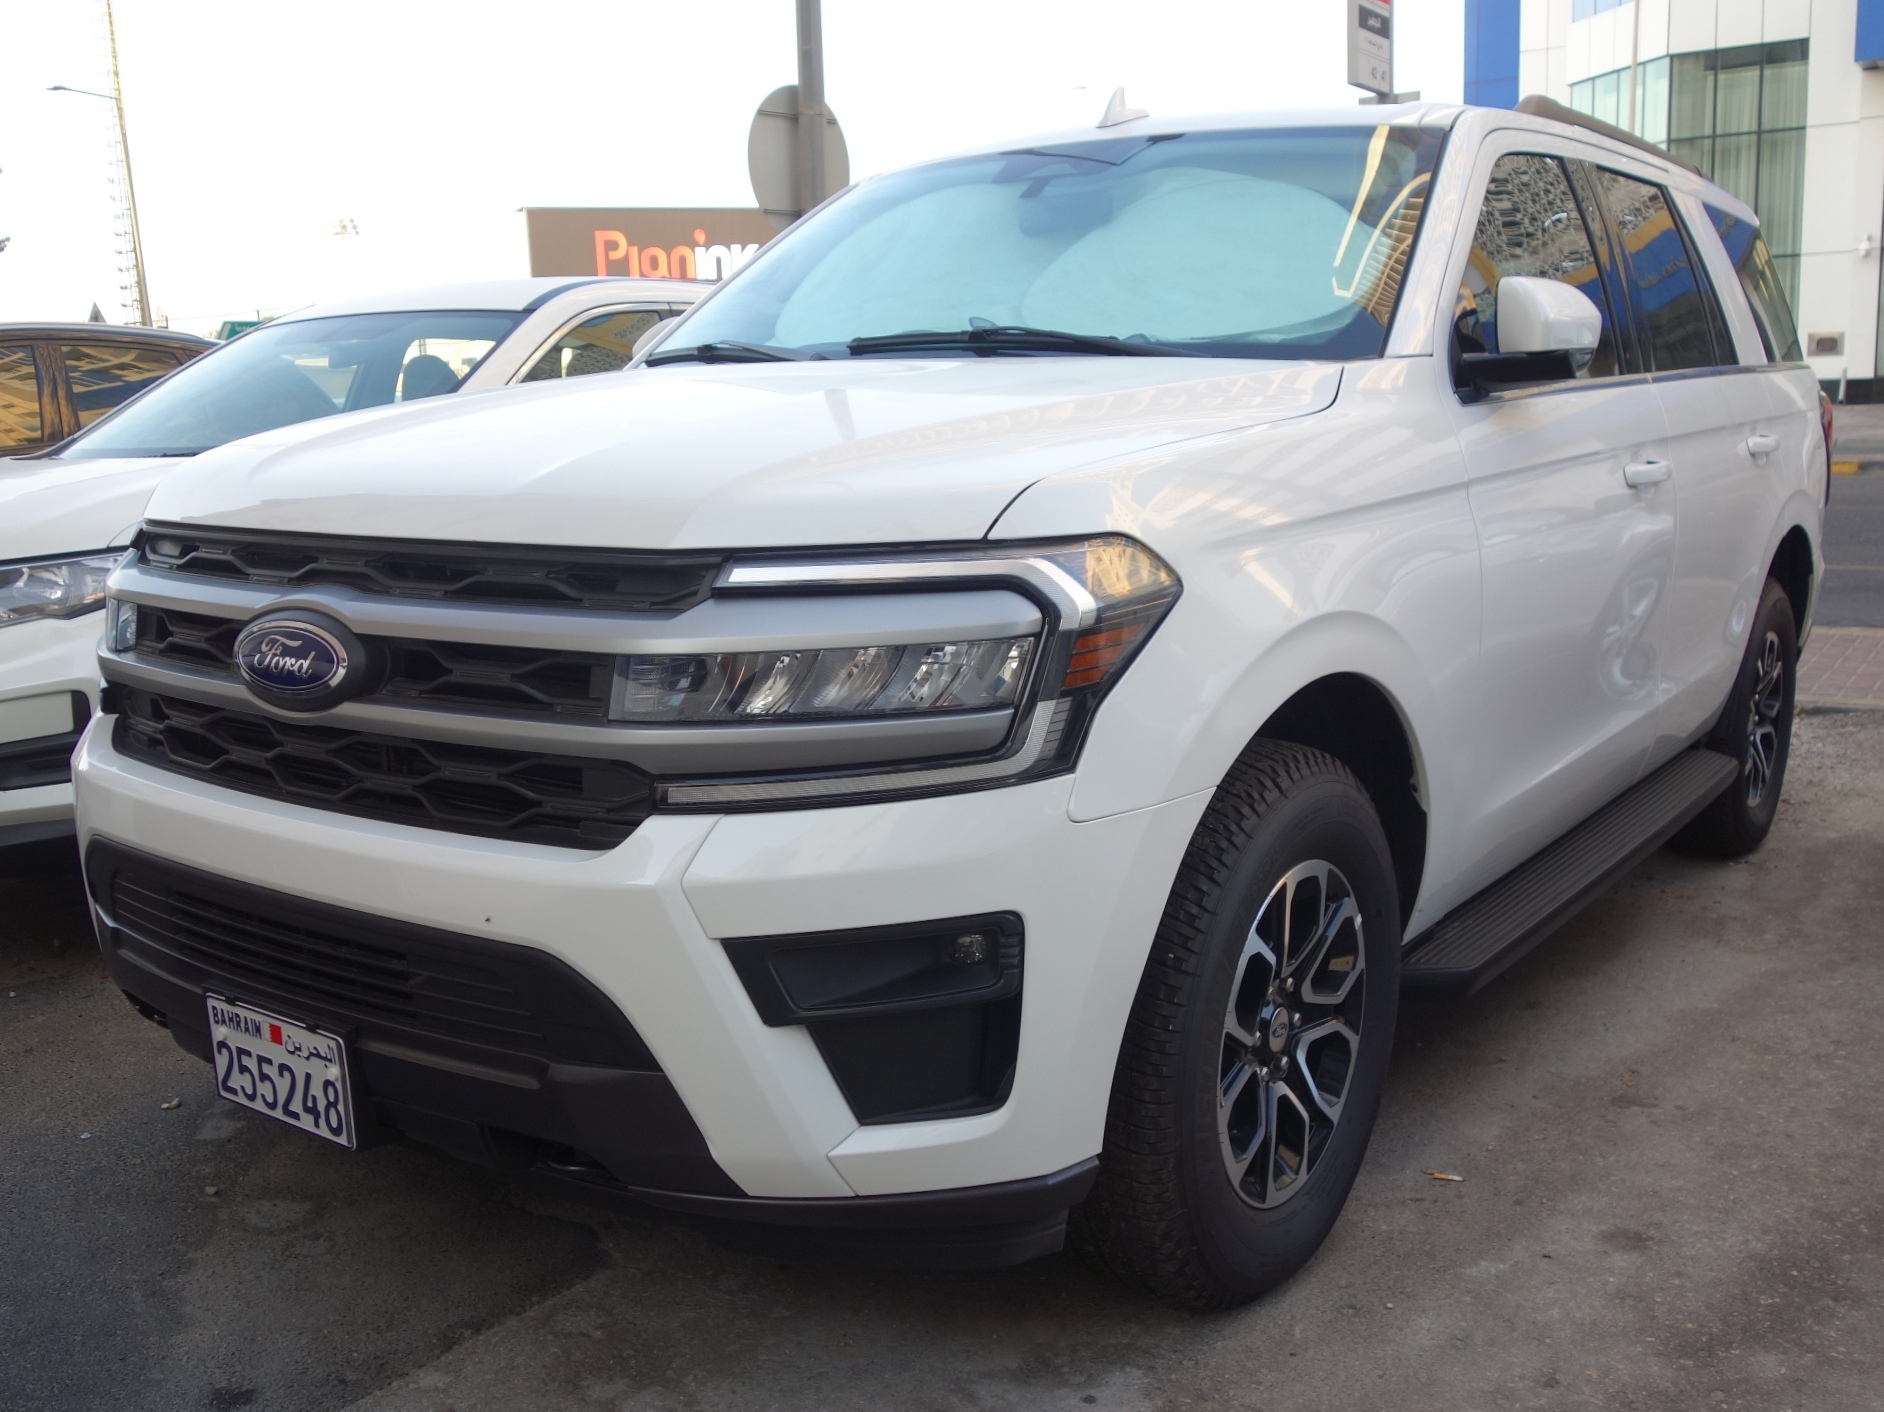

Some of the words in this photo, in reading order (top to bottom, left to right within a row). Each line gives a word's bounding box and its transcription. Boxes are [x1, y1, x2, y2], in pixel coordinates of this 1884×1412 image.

[254, 635, 316, 678] Ford
[211, 1005, 263, 1040] BAHRAIN
[285, 1034, 337, 1069] البحرين
[216, 1040, 344, 1137] 255248
